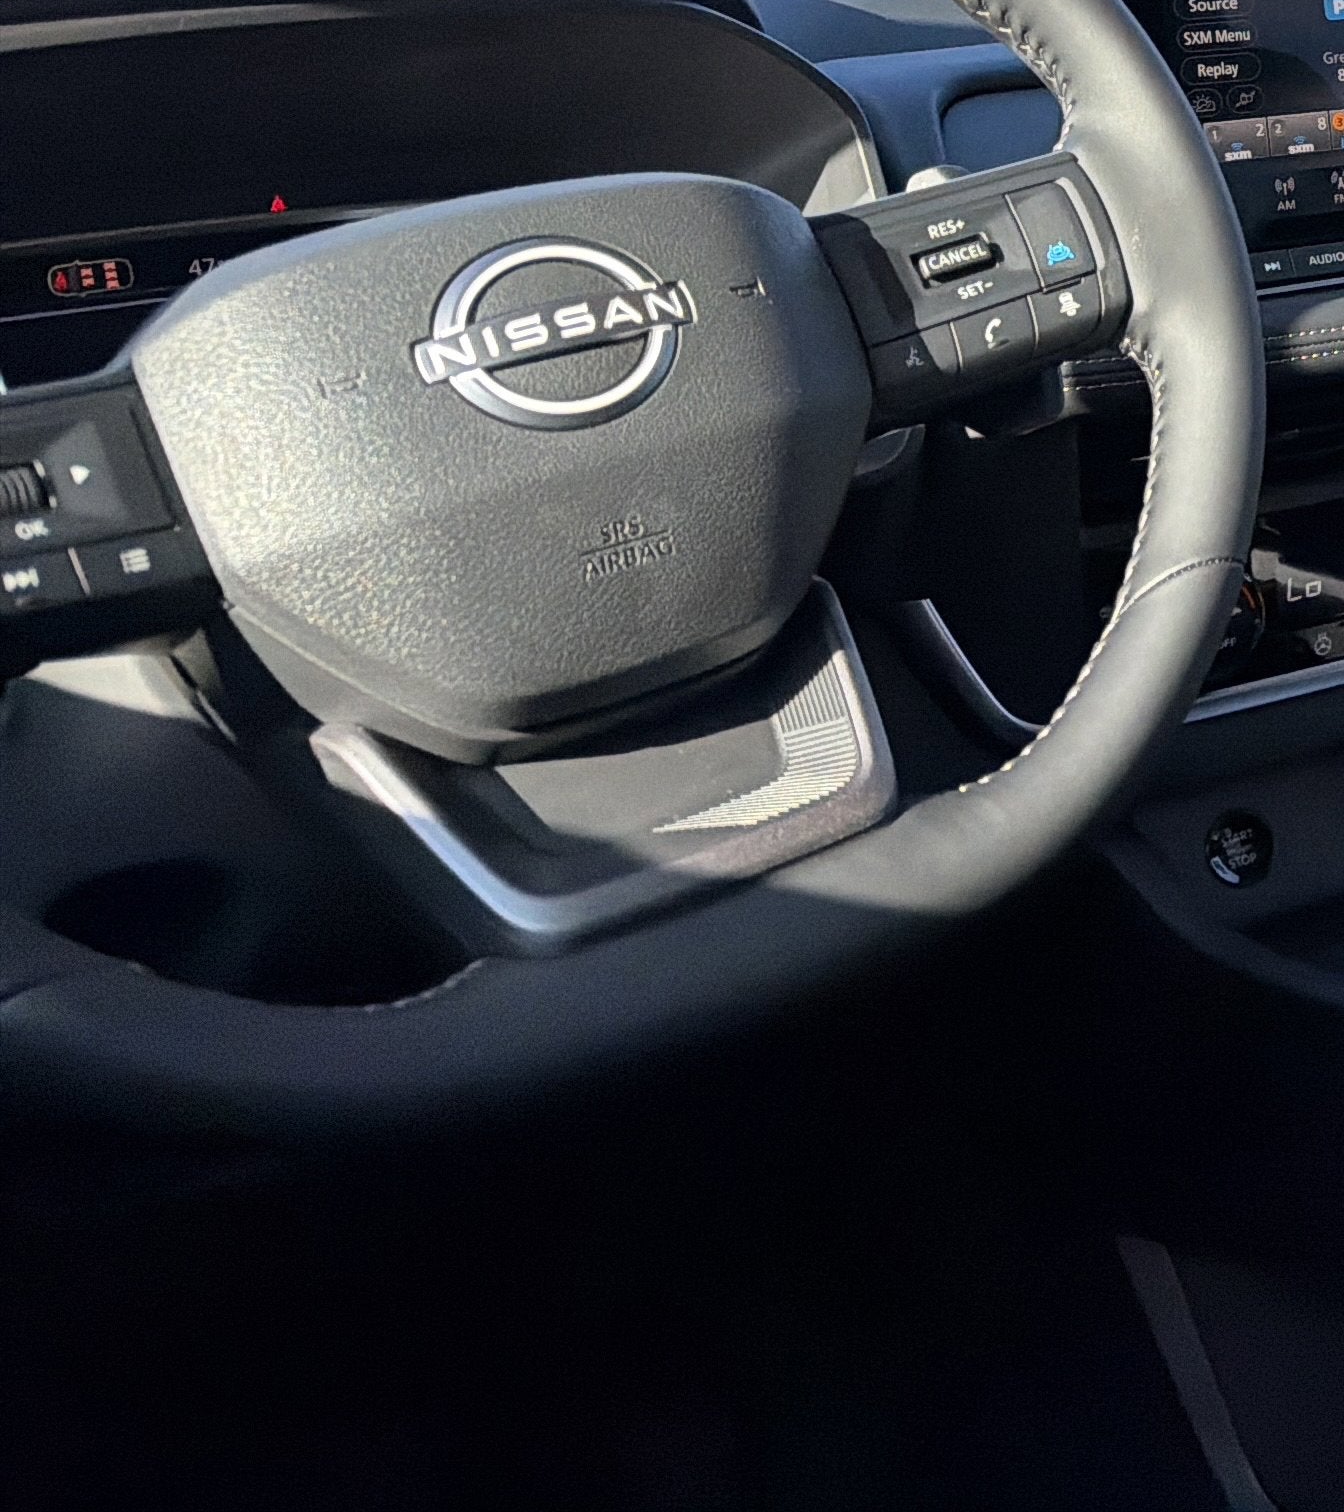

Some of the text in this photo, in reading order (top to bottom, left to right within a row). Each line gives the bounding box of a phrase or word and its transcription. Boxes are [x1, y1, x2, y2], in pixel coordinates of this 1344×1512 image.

[1182, 29, 1251, 47] SXM Menu
[1196, 60, 1239, 80] Replay
[1254, 123, 1265, 137] 2
[1317, 116, 1327, 131] 8
[1224, 149, 1252, 162] sxm
[1287, 142, 1315, 154] sxm
[1277, 199, 1297, 212] AM
[926, 218, 966, 241] RES+
[927, 242, 989, 271] CANCEL
[957, 280, 994, 301] SET-
[425, 288, 685, 377] NISSAN
[14, 517, 50, 541] OK
[600, 516, 644, 544] SRS
[584, 531, 677, 583] AIRBAG
[1286, 576, 1322, 603] Lo
[1228, 852, 1258, 870] STOP
